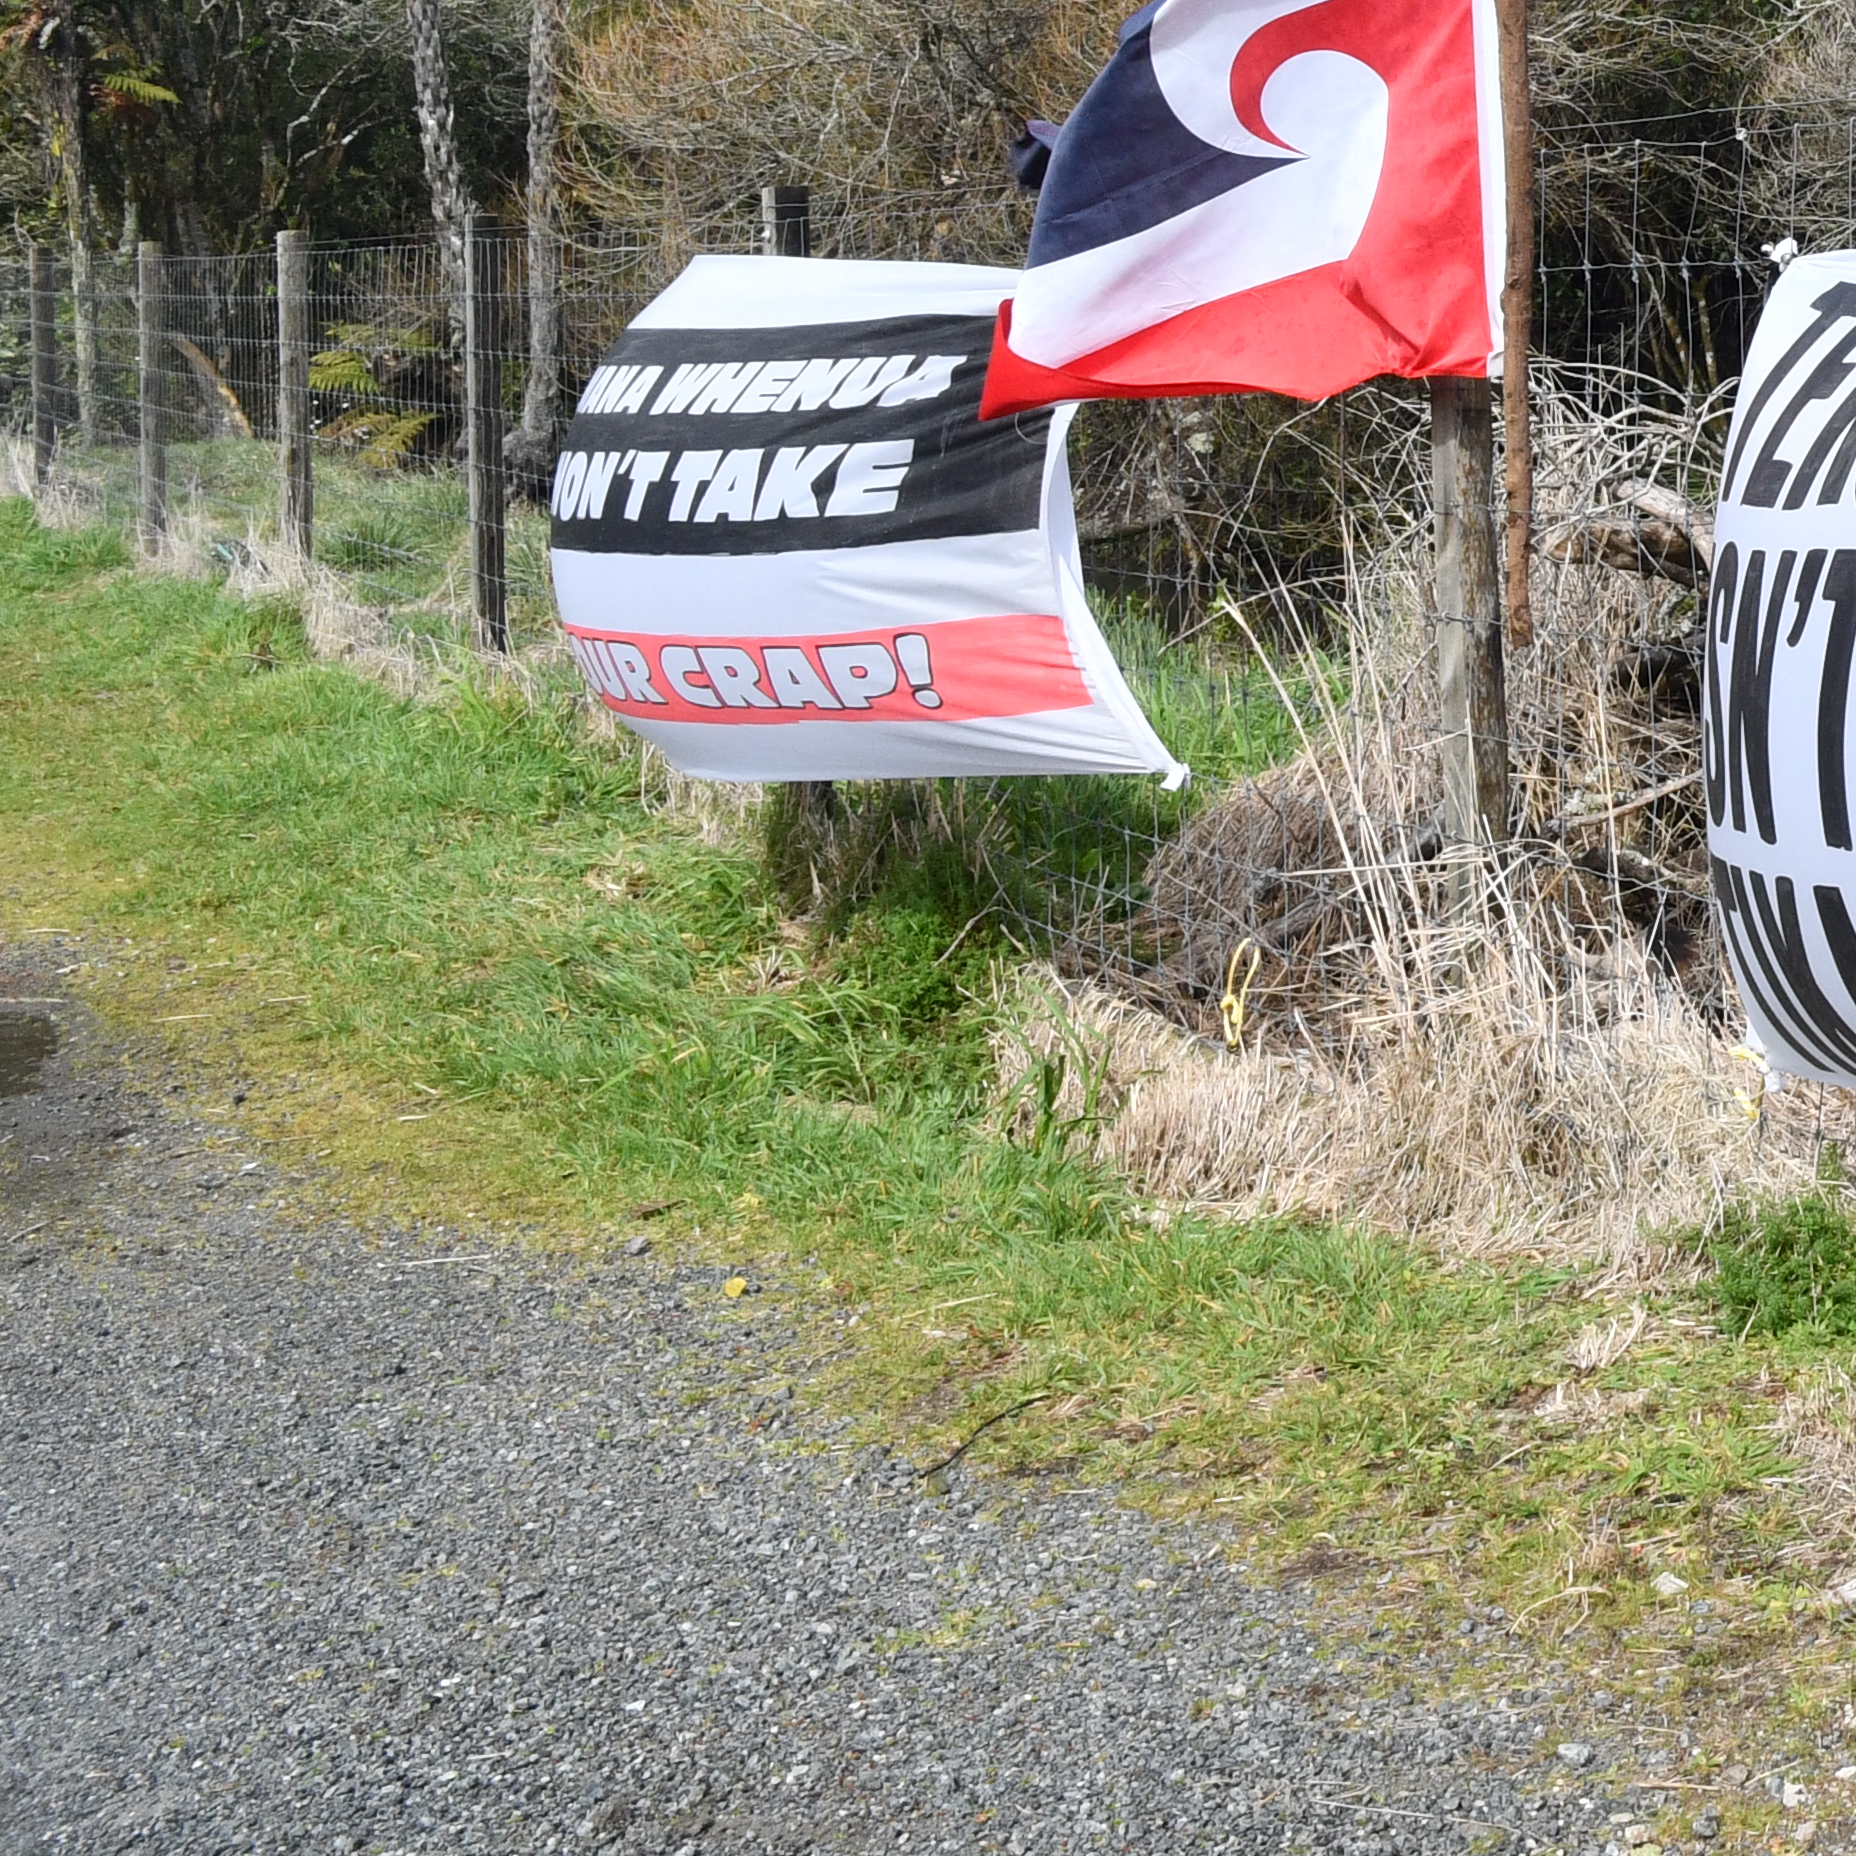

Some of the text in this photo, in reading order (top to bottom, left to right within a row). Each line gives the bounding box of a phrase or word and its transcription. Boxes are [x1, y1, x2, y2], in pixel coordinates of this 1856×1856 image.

[648, 354, 968, 416] WHENUA
[667, 439, 915, 524] TAKE
[658, 632, 943, 711] CRAP!
